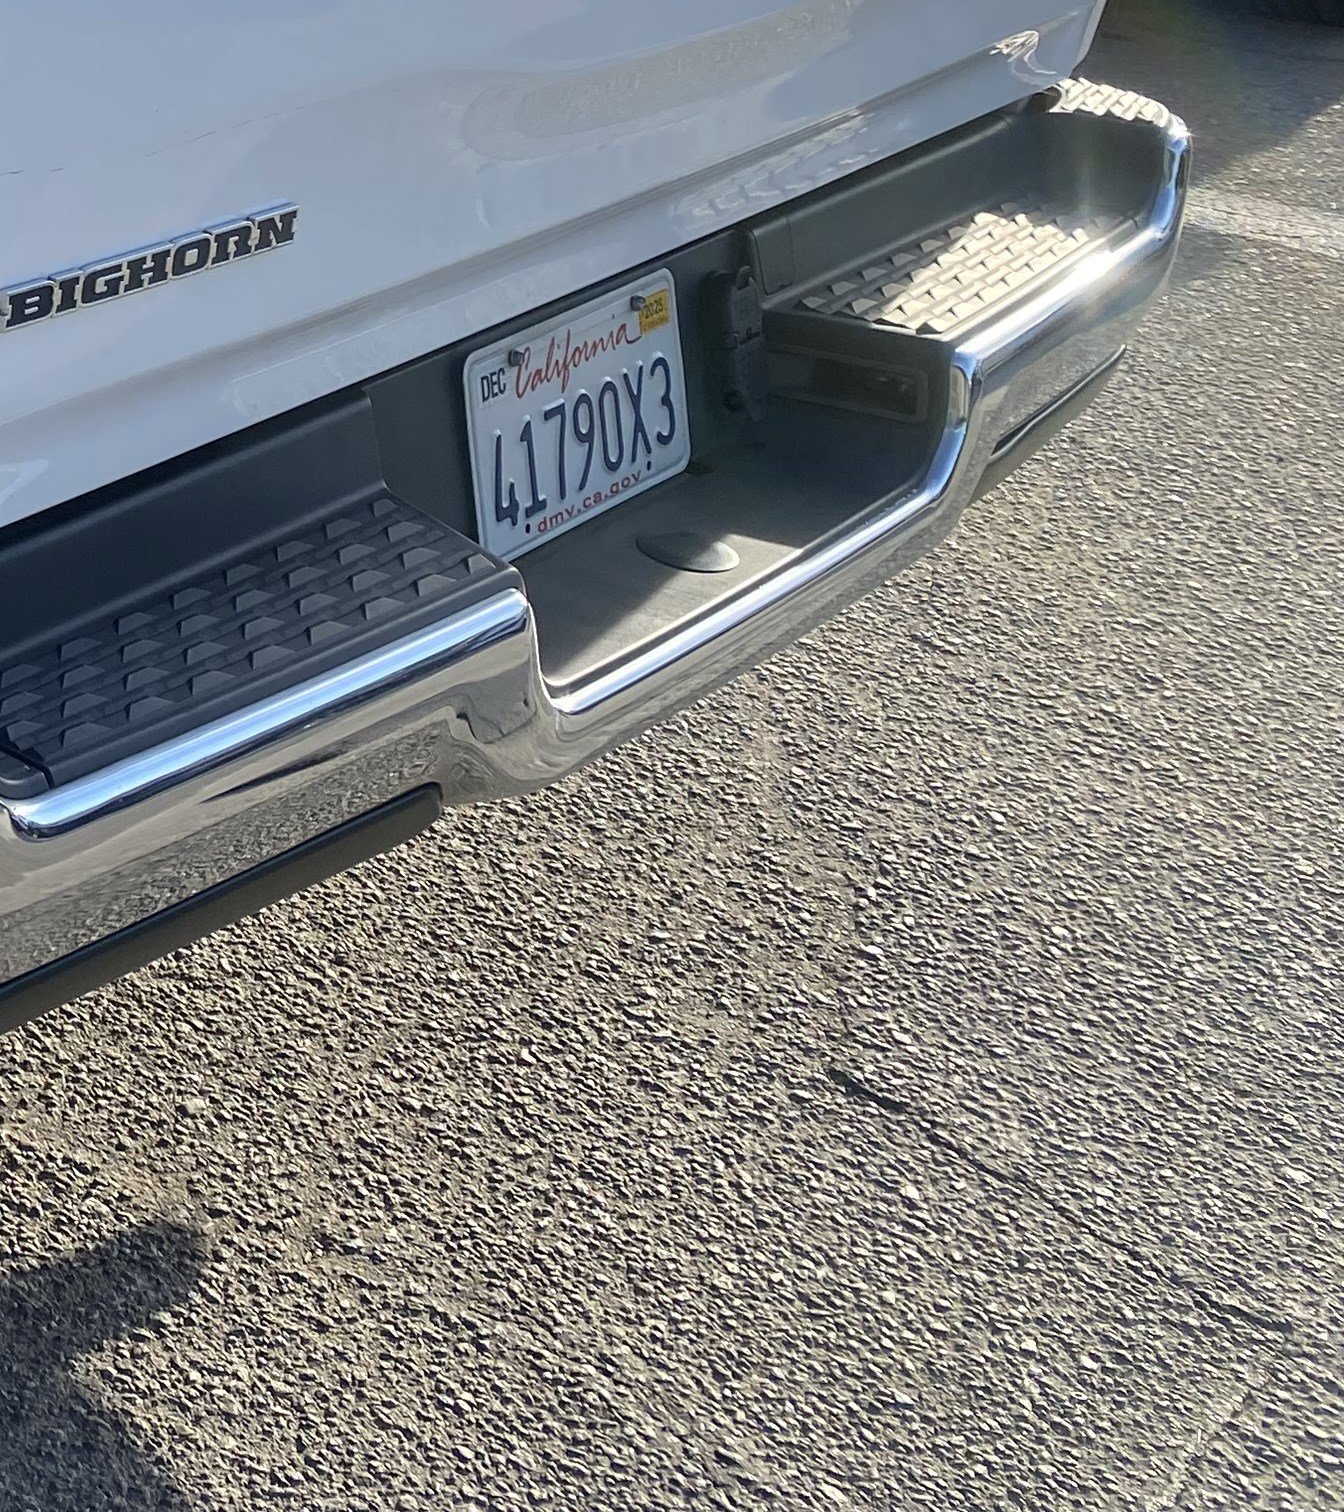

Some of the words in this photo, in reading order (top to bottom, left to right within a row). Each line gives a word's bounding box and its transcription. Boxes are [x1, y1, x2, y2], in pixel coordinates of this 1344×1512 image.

[480, 367, 506, 403] DEC
[513, 315, 642, 400] California
[495, 355, 676, 526] 41790X3
[538, 470, 641, 534] dmv.ca.gov
